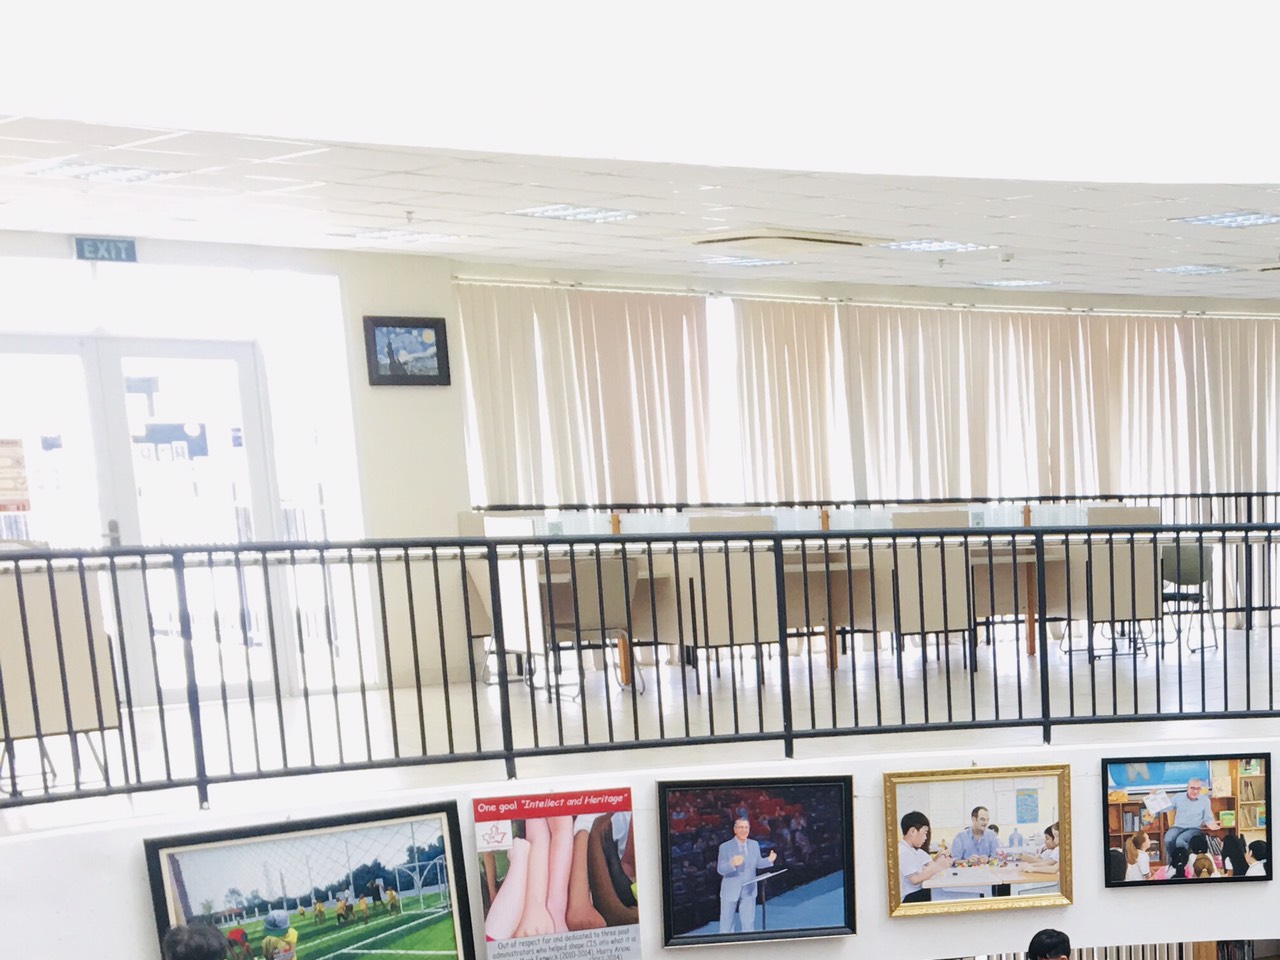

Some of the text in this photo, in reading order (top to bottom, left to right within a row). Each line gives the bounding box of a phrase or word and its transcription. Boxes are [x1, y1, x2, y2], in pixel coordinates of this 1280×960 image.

[83, 240, 128, 260] EXIT
[478, 803, 496, 812] One
[499, 802, 517, 814] goal
[567, 796, 582, 805] and
[498, 941, 509, 949] Out
[519, 938, 540, 948] respect
[553, 935, 563, 943] and
[565, 932, 592, 942] dedicated
[601, 929, 617, 938] three
[492, 949, 534, 960] administrators
[536, 946, 547, 954] who
[548, 943, 567, 953] helped
[569, 942, 584, 951] shape
[586, 940, 597, 948] CIS
